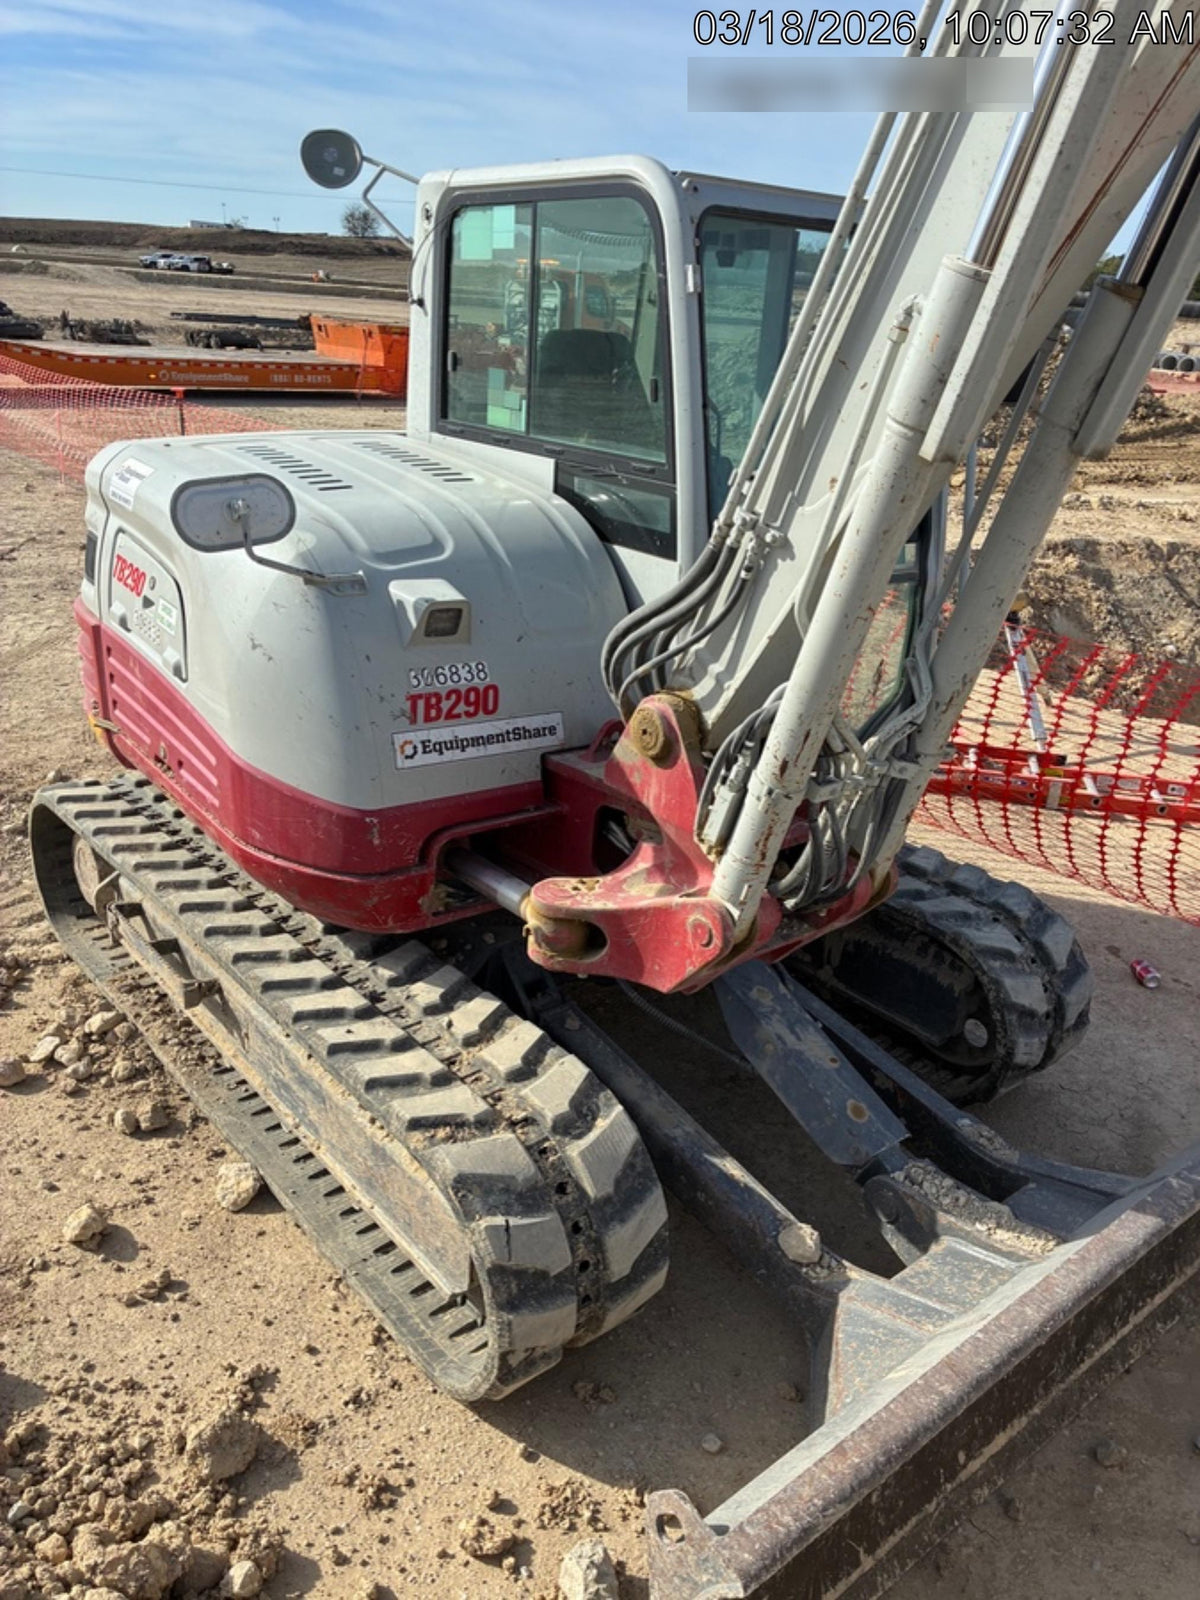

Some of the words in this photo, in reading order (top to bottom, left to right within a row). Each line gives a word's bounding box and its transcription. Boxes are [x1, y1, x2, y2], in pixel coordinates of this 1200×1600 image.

[113, 554, 146, 597] TB290
[406, 684, 499, 725] TB290
[421, 724, 557, 755] EquipmentShare
